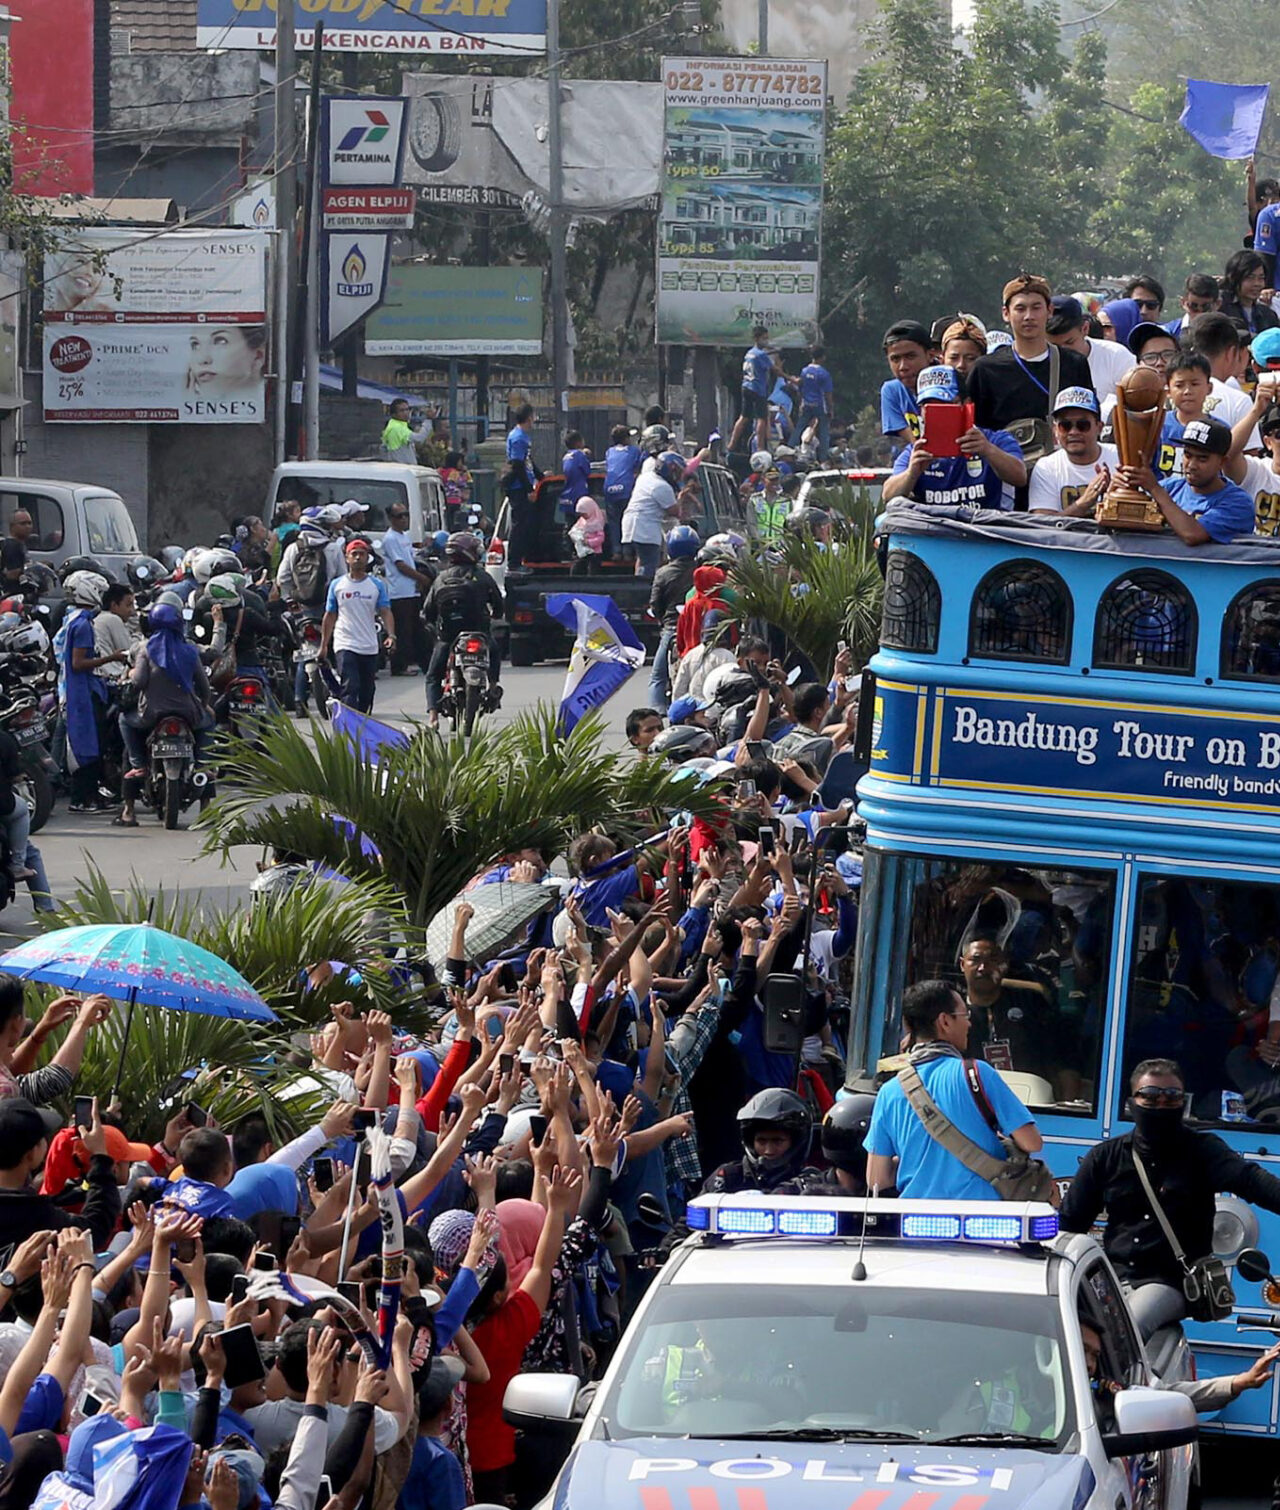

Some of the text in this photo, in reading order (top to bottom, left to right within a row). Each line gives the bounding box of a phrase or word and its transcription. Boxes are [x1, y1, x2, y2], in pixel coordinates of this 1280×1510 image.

[323, 33, 432, 49] KENCANA
[440, 37, 486, 50] BAN
[686, 61, 742, 71] INFORMASI
[667, 72, 703, 91] 022
[722, 74, 822, 95] 87774782
[667, 94, 822, 108] www.greenhanjuang.com
[334, 153, 391, 163] PERTAMINA
[327, 196, 409, 208] AGEN ELPIJI
[422, 187, 479, 203] CILEMBER
[338, 284, 373, 295] ELPIJI
[58, 341, 81, 357] NEW
[58, 382, 84, 401] 25%
[925, 484, 986, 504] BOBOTOH
[953, 706, 1099, 765] Bandung
[1113, 720, 1194, 763] Tour
[1206, 738, 1247, 767] on
[627, 1456, 1014, 1492] POLISI
